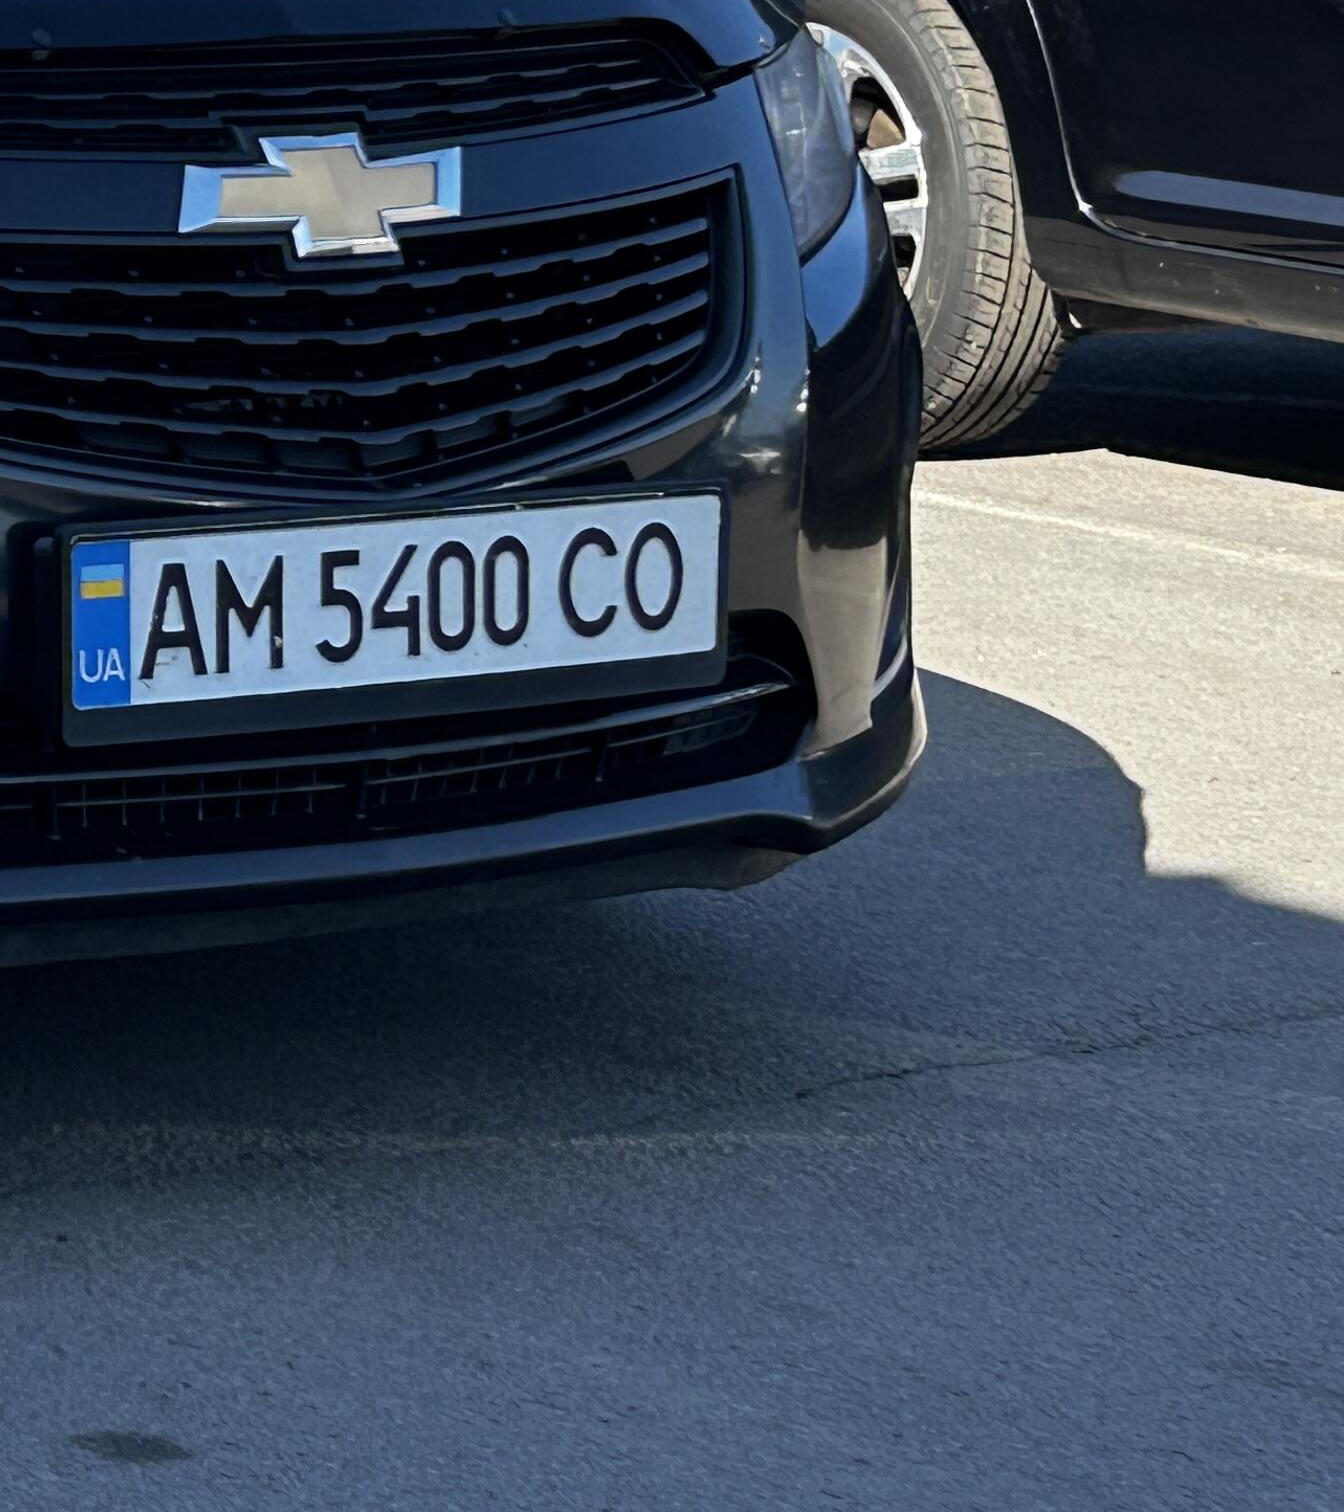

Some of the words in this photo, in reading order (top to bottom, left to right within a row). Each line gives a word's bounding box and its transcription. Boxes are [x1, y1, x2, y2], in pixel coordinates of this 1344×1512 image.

[139, 554, 284, 681] AM
[315, 534, 530, 664] 5400
[558, 521, 684, 638] CO
[79, 648, 125, 683] UA
